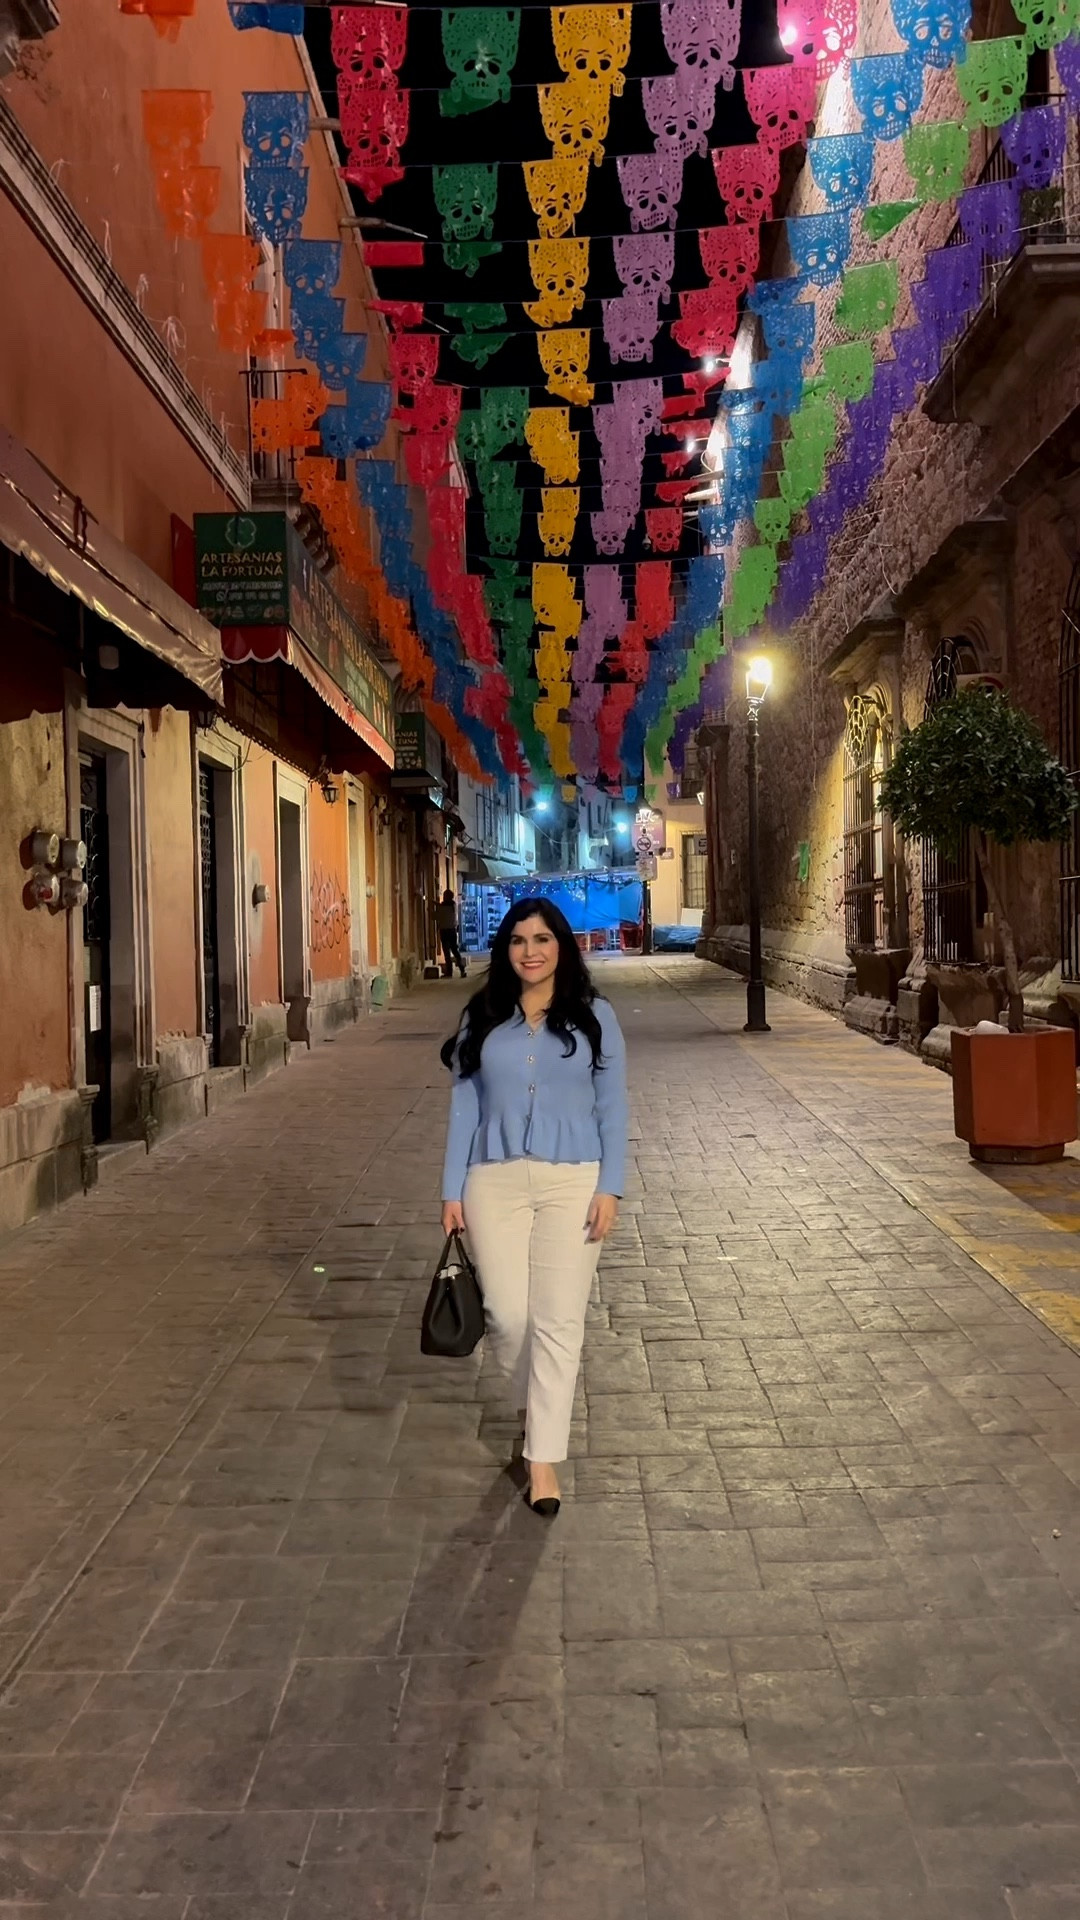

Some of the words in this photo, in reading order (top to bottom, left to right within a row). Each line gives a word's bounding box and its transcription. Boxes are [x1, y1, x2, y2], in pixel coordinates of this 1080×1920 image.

[201, 552, 283, 563] ARTESANIAS
[201, 565, 219, 577] LA
[222, 564, 283, 577] FORTUNA
